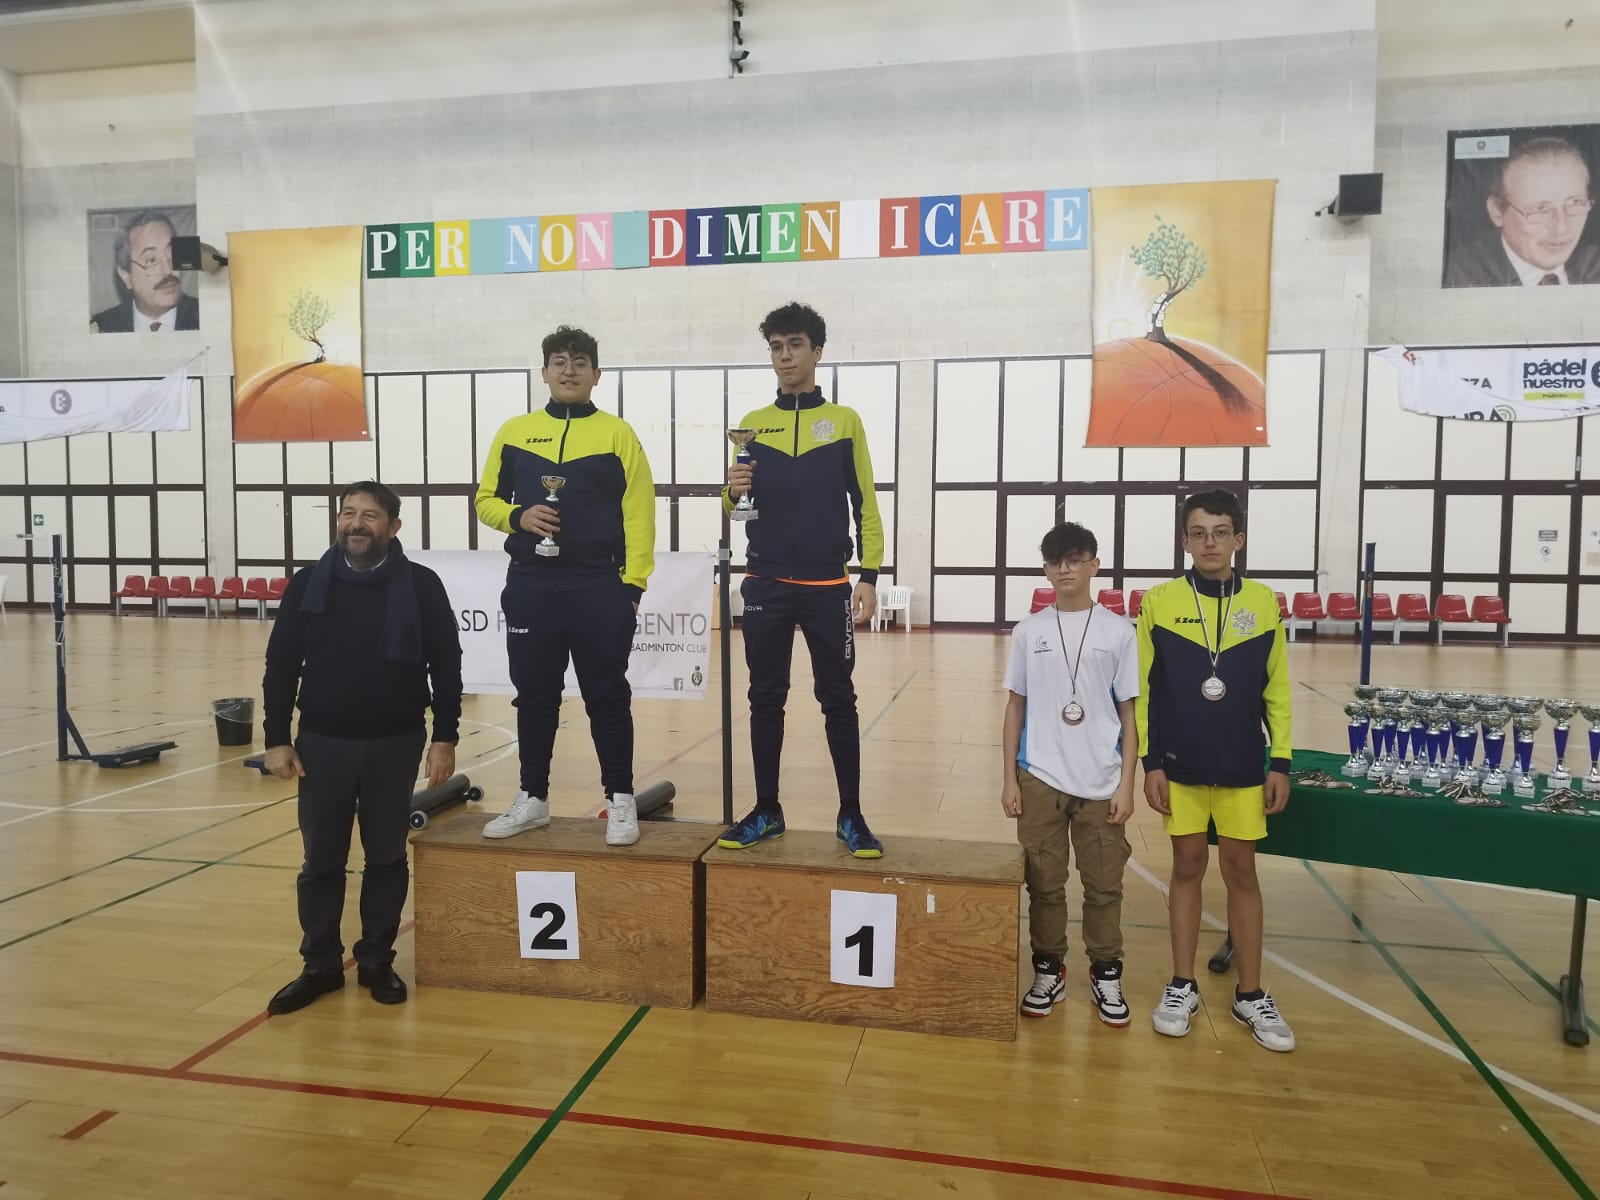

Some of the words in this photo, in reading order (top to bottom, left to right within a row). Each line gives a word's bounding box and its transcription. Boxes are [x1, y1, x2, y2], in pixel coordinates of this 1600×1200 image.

[369, 227, 467, 272] PER
[506, 220, 610, 266] NON
[1523, 358, 1587, 379] pádel
[1523, 377, 1586, 389] nuestro
[456, 609, 489, 632] SD
[631, 642, 684, 652] BADMINTON
[687, 643, 707, 654] CLUB
[529, 902, 568, 951] 2
[845, 925, 874, 977] 1
